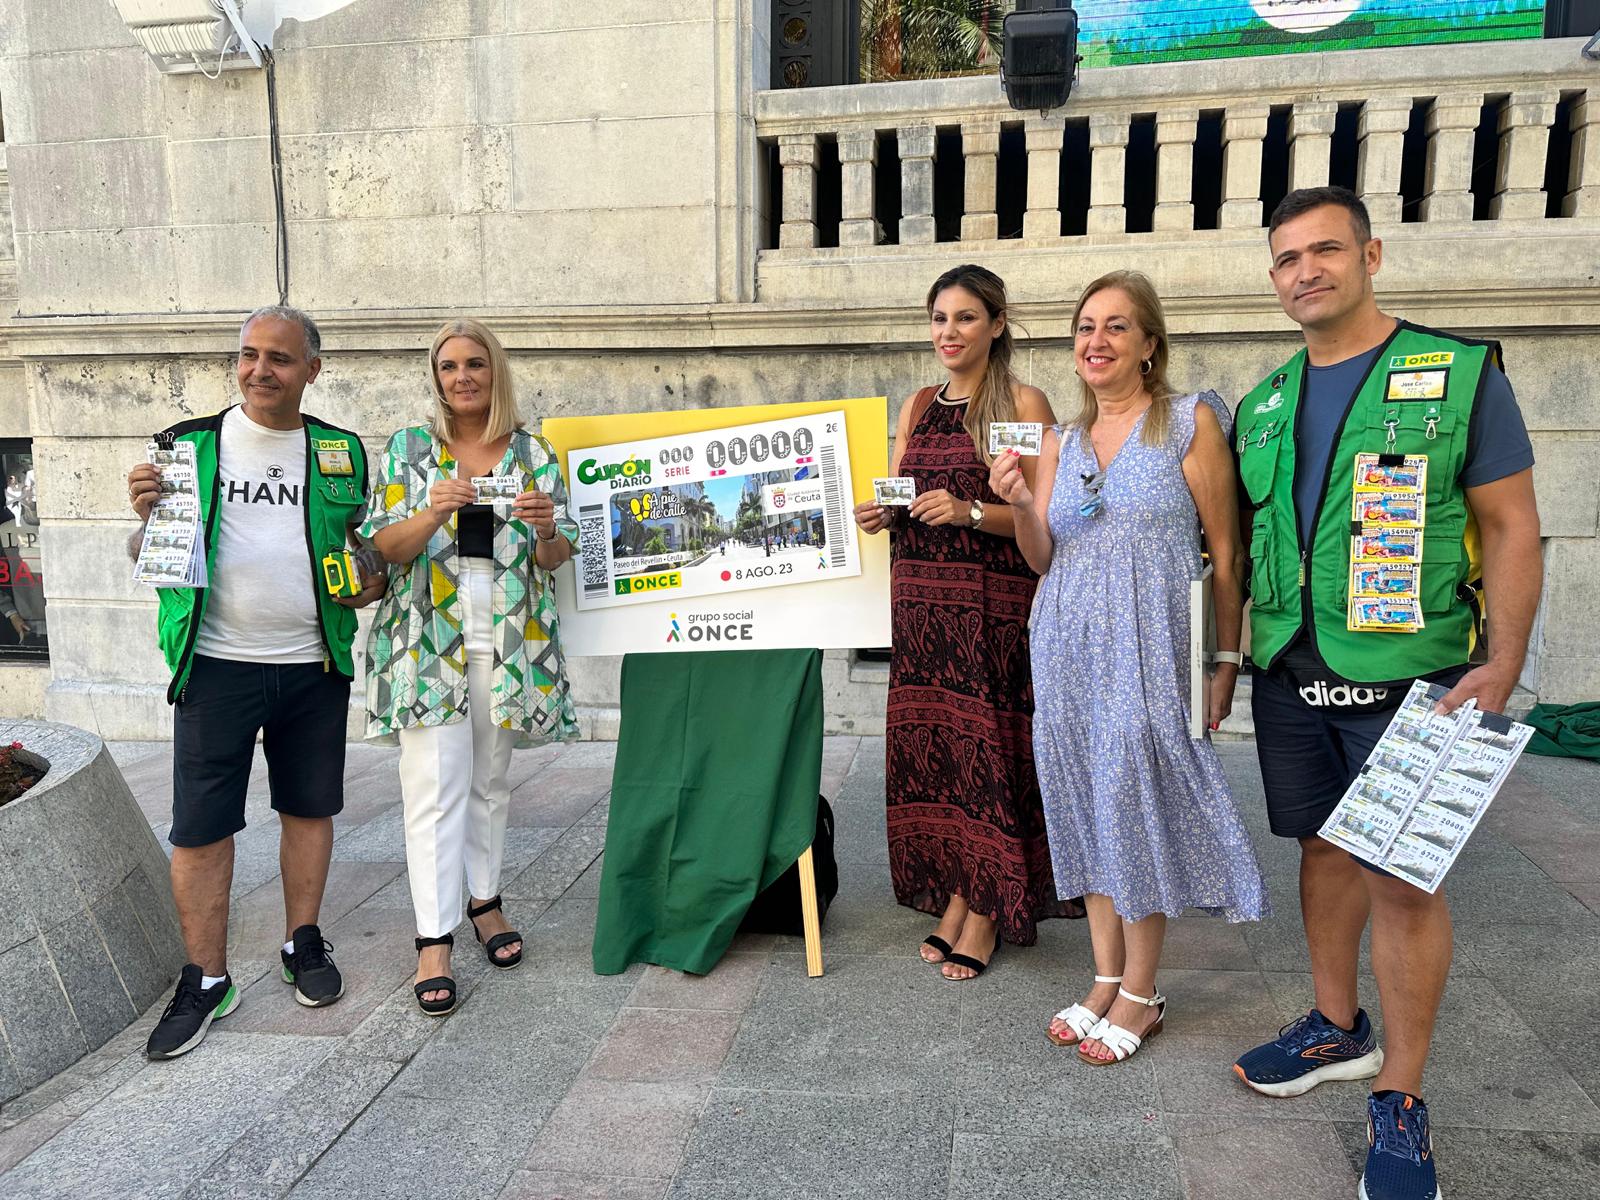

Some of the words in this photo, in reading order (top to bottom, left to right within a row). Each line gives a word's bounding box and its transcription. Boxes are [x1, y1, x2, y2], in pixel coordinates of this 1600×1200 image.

[1409, 354, 1449, 365] ONCE
[826, 423, 838, 434] 2€
[321, 441, 347, 449] ONCE
[706, 427, 814, 469] 00000
[659, 445, 694, 466] 000
[664, 466, 691, 478] SERIE
[220, 480, 305, 506] HAN
[661, 490, 680, 510] pie
[795, 493, 821, 504] Ceuta
[650, 506, 662, 520] de
[663, 503, 687, 518] calle
[613, 560, 630, 569] Paseo
[631, 558, 640, 567] del
[667, 554, 684, 562] Ceuta
[735, 569, 743, 580] 8
[745, 565, 777, 579] AGO.
[779, 562, 793, 575] 23
[633, 574, 678, 591] ONCE
[688, 613, 721, 624] grupo
[723, 609, 753, 620] social
[688, 624, 753, 642] ONCE
